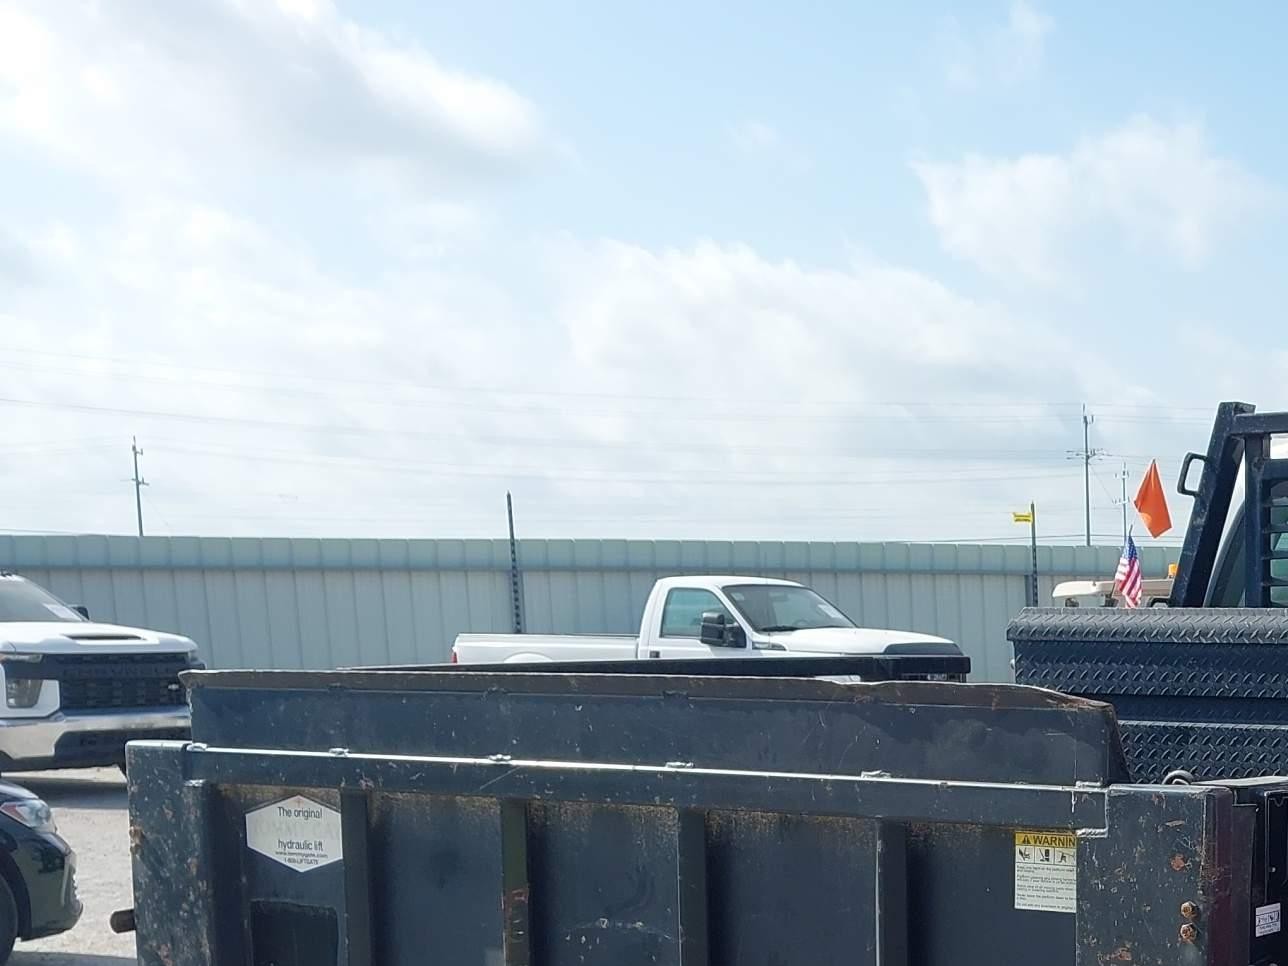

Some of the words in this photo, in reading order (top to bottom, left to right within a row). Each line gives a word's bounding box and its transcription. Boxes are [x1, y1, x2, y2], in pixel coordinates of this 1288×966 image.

[278, 807, 292, 818] The
[293, 807, 323, 820] original
[278, 840, 312, 852] hydraulic
[314, 840, 324, 852] lift
[1033, 834, 1076, 848] WARNIN
